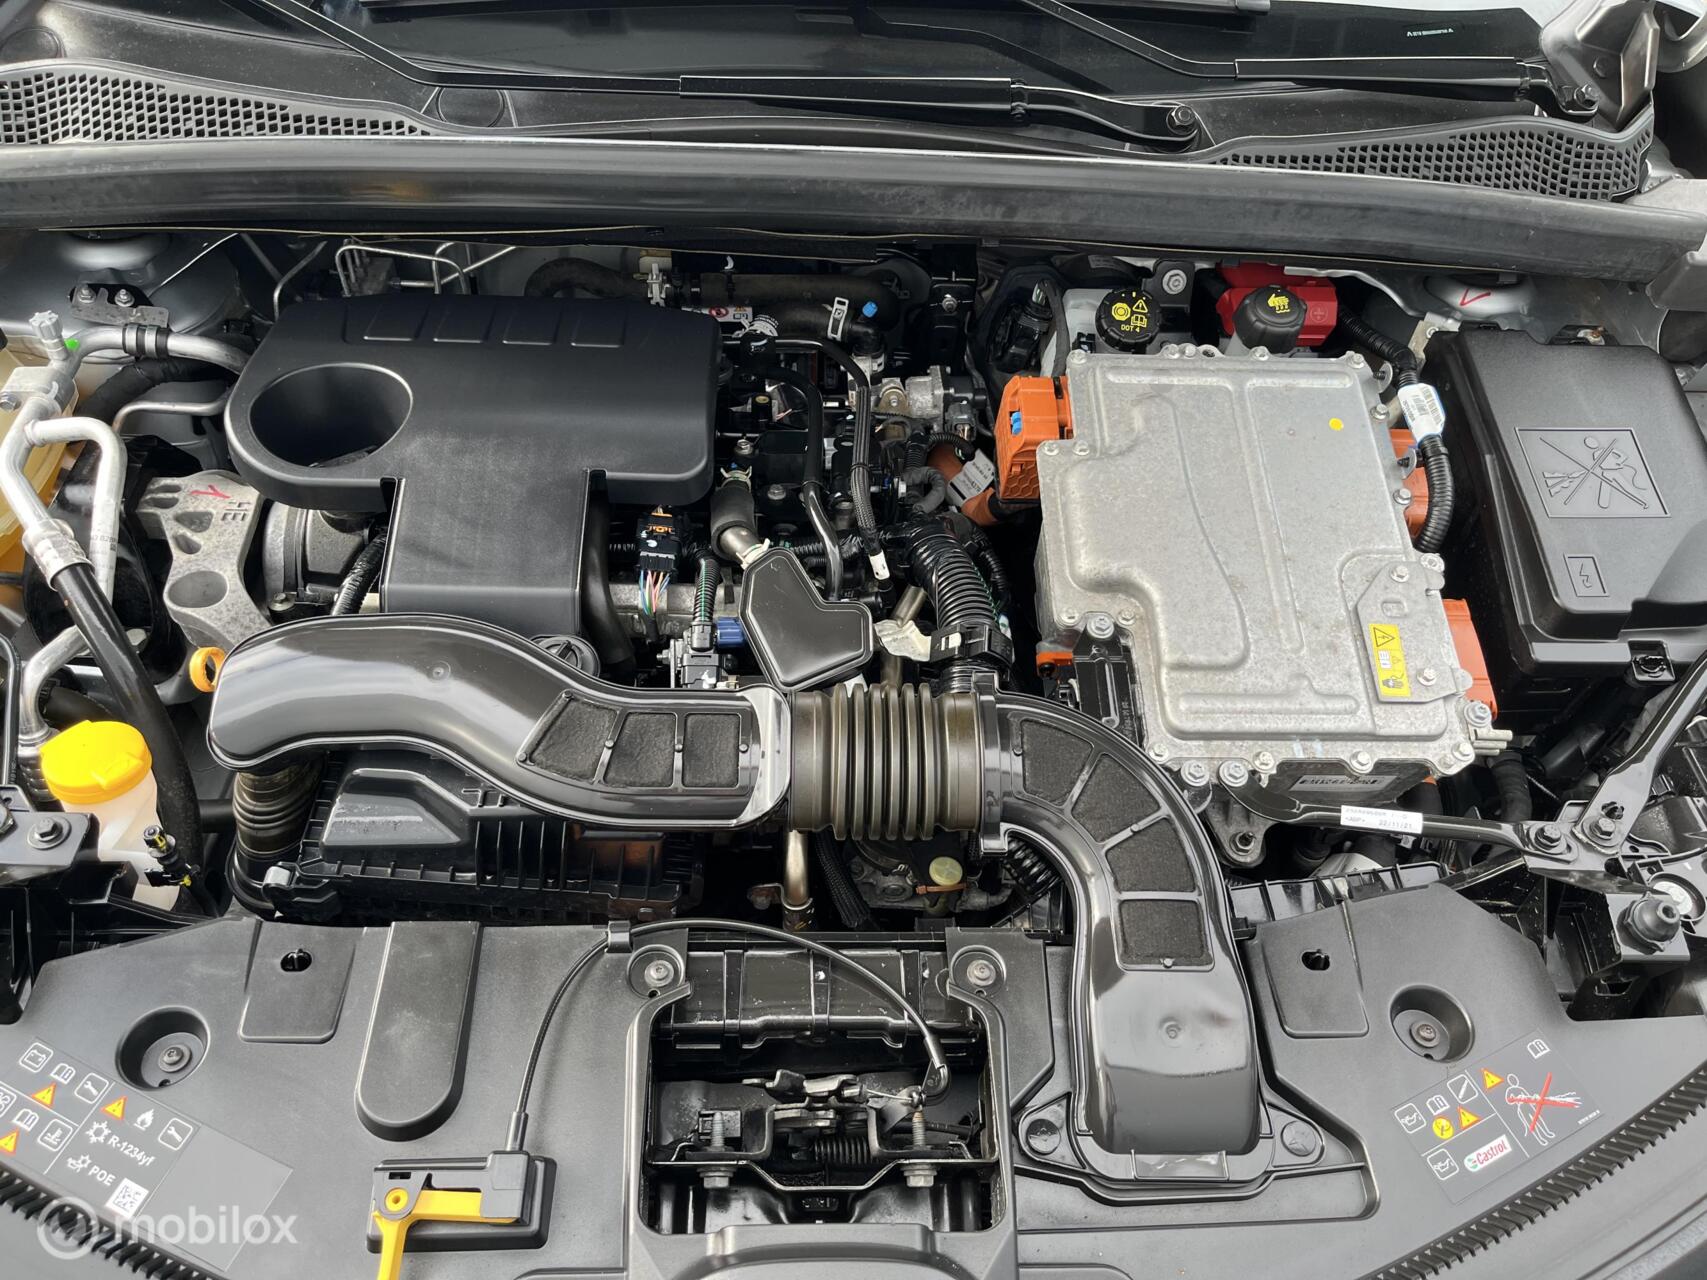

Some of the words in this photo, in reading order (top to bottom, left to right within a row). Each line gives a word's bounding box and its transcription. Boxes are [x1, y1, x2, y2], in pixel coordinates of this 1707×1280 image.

[1120, 324, 1134, 332] DOT
[107, 1134, 155, 1166] R-1234yf
[1476, 1139, 1508, 1165] Castrol
[88, 1165, 116, 1187] POE
